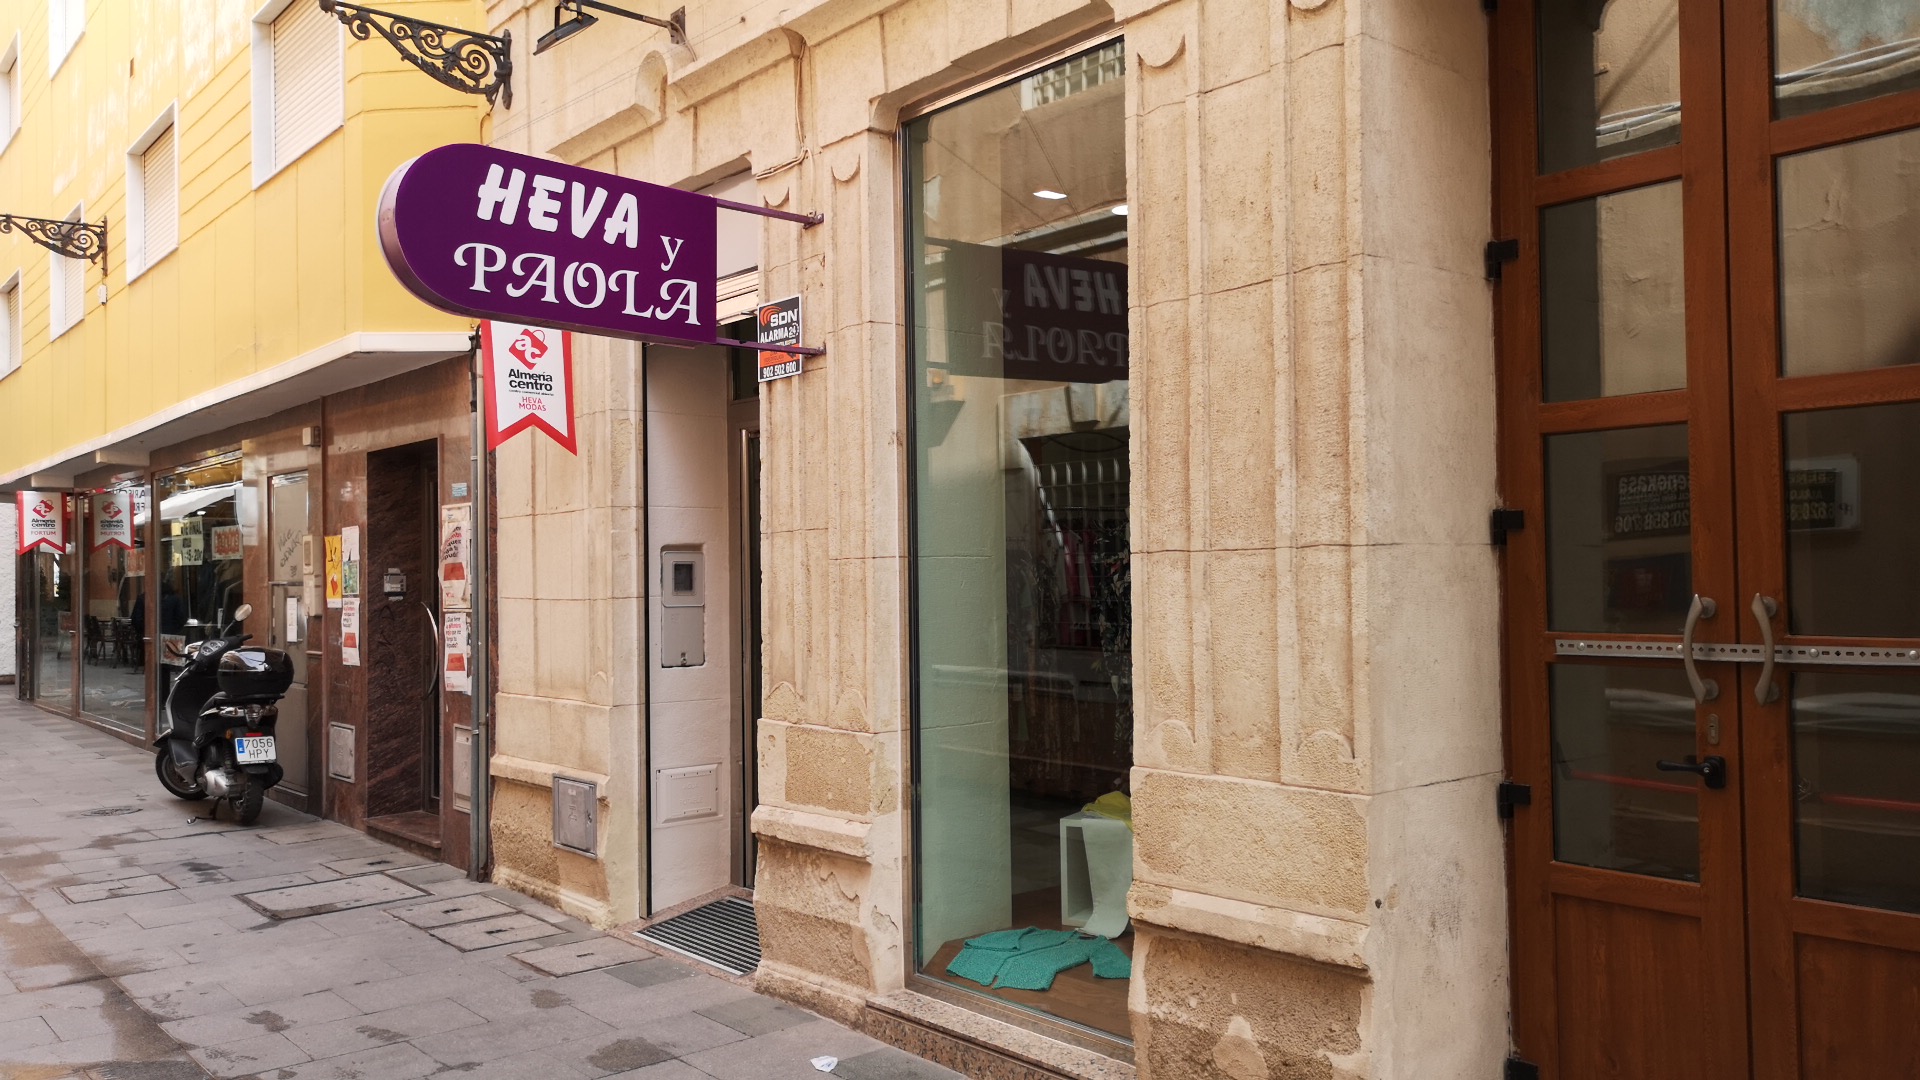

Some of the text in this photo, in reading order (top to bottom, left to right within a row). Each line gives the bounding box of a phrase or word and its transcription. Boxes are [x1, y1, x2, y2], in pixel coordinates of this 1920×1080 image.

[477, 163, 684, 272] HEVA y
[454, 242, 701, 326] PAOLA
[770, 308, 798, 327] SDN
[760, 326, 788, 343] ALARMA
[763, 361, 797, 378] 902 502 600
[509, 379, 553, 391] centro
[518, 402, 547, 411] MODAS
[521, 396, 543, 404] HEVA
[244, 738, 273, 749] 7056
[249, 749, 269, 759] HPY
